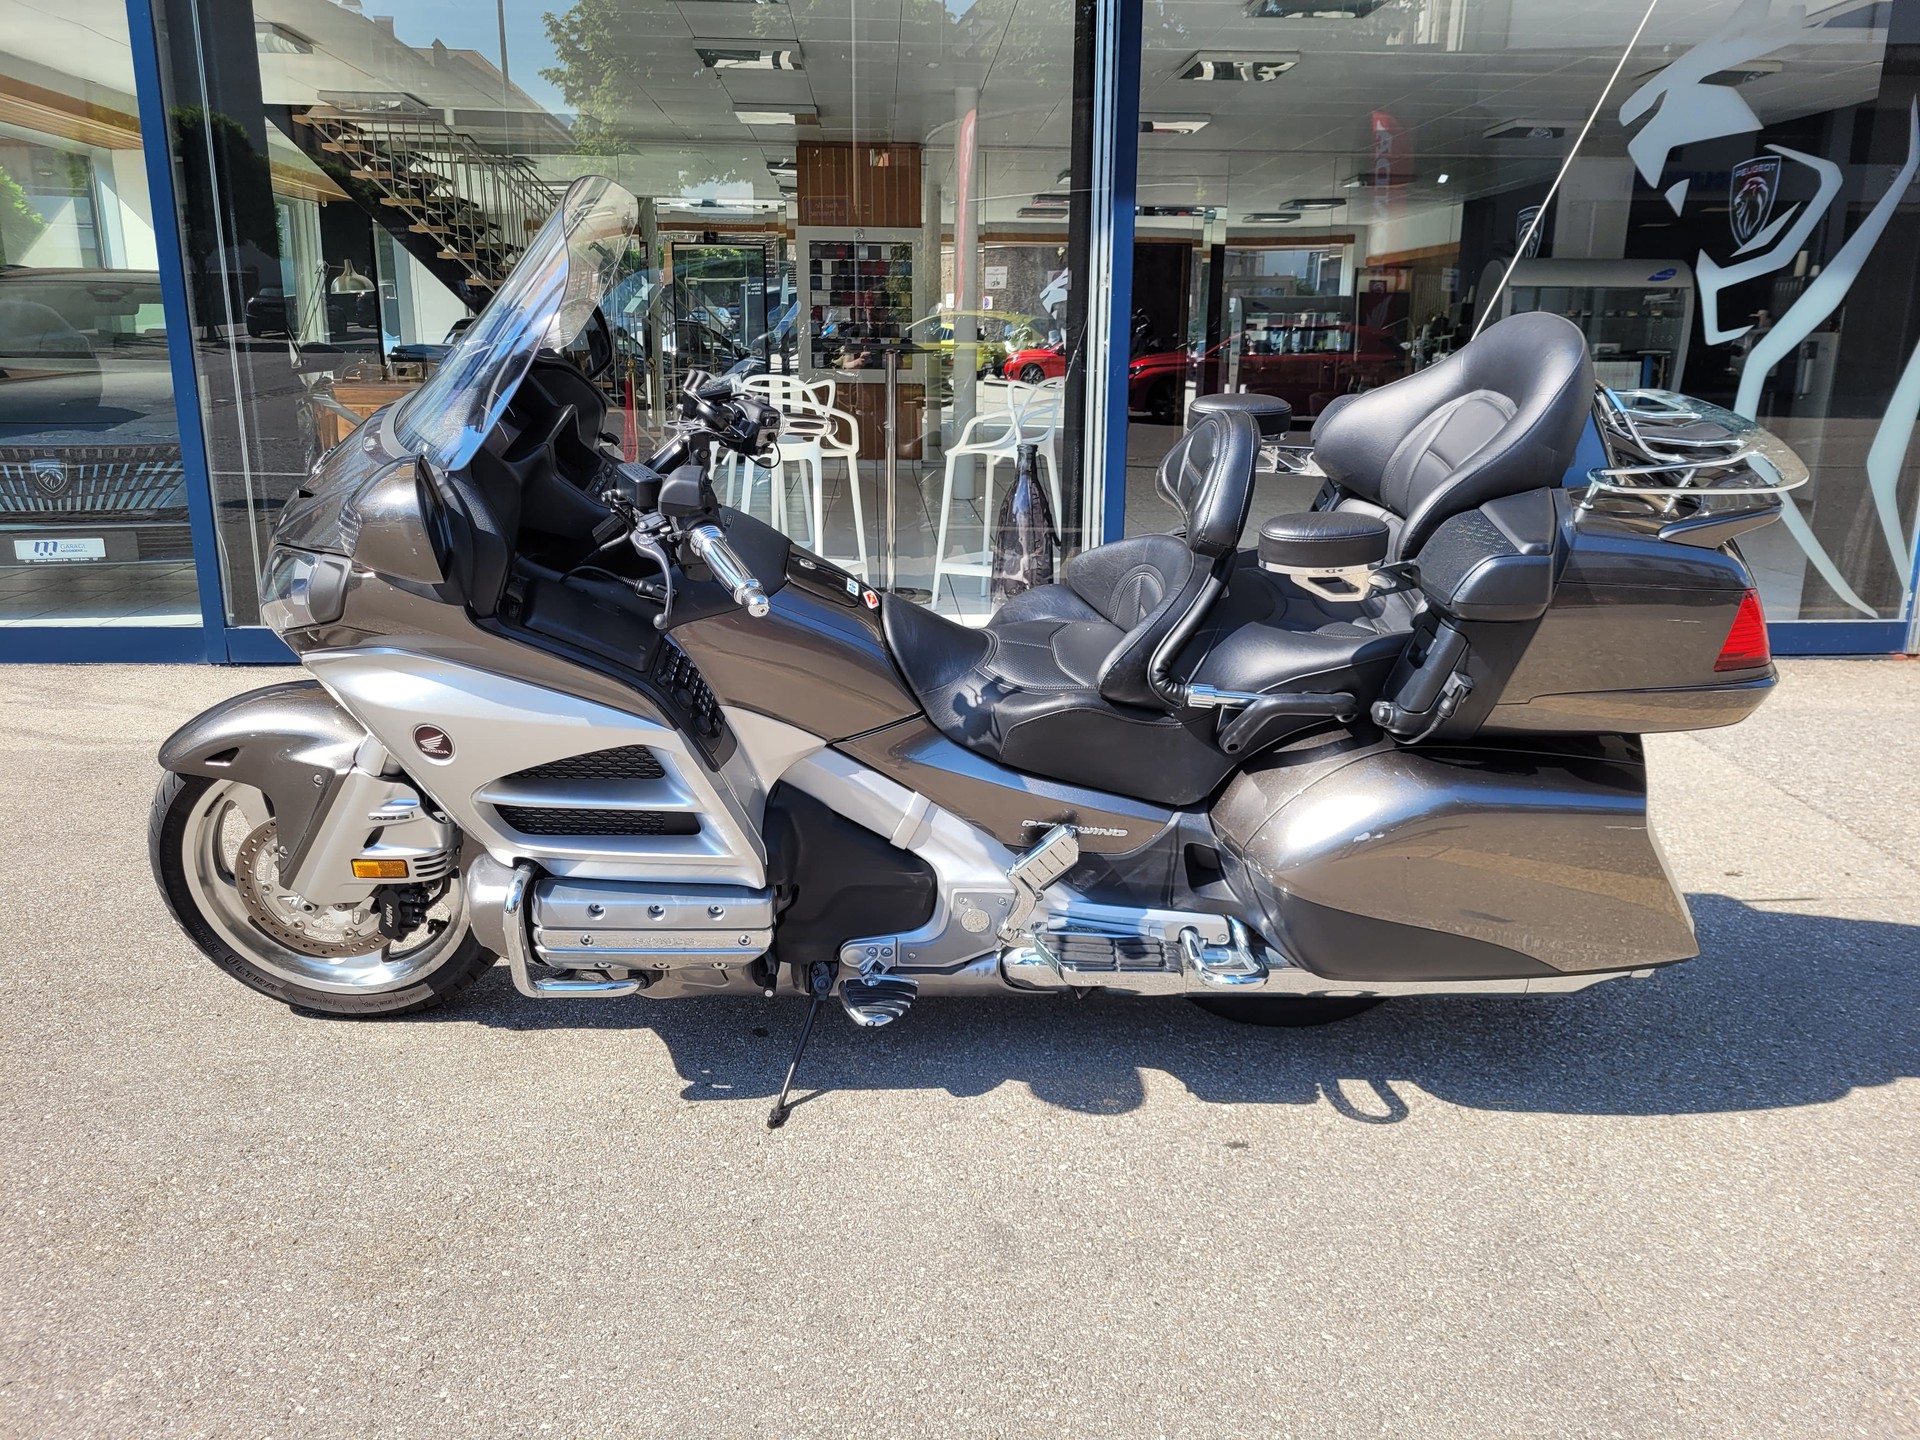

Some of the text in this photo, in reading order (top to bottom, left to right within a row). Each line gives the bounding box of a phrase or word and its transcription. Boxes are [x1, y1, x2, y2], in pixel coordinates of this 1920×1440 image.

[1735, 163, 1777, 178] PEUGEOT
[421, 747, 451, 755] HONDA
[1077, 825, 1129, 837] WING
[224, 954, 279, 992] ULTRA
